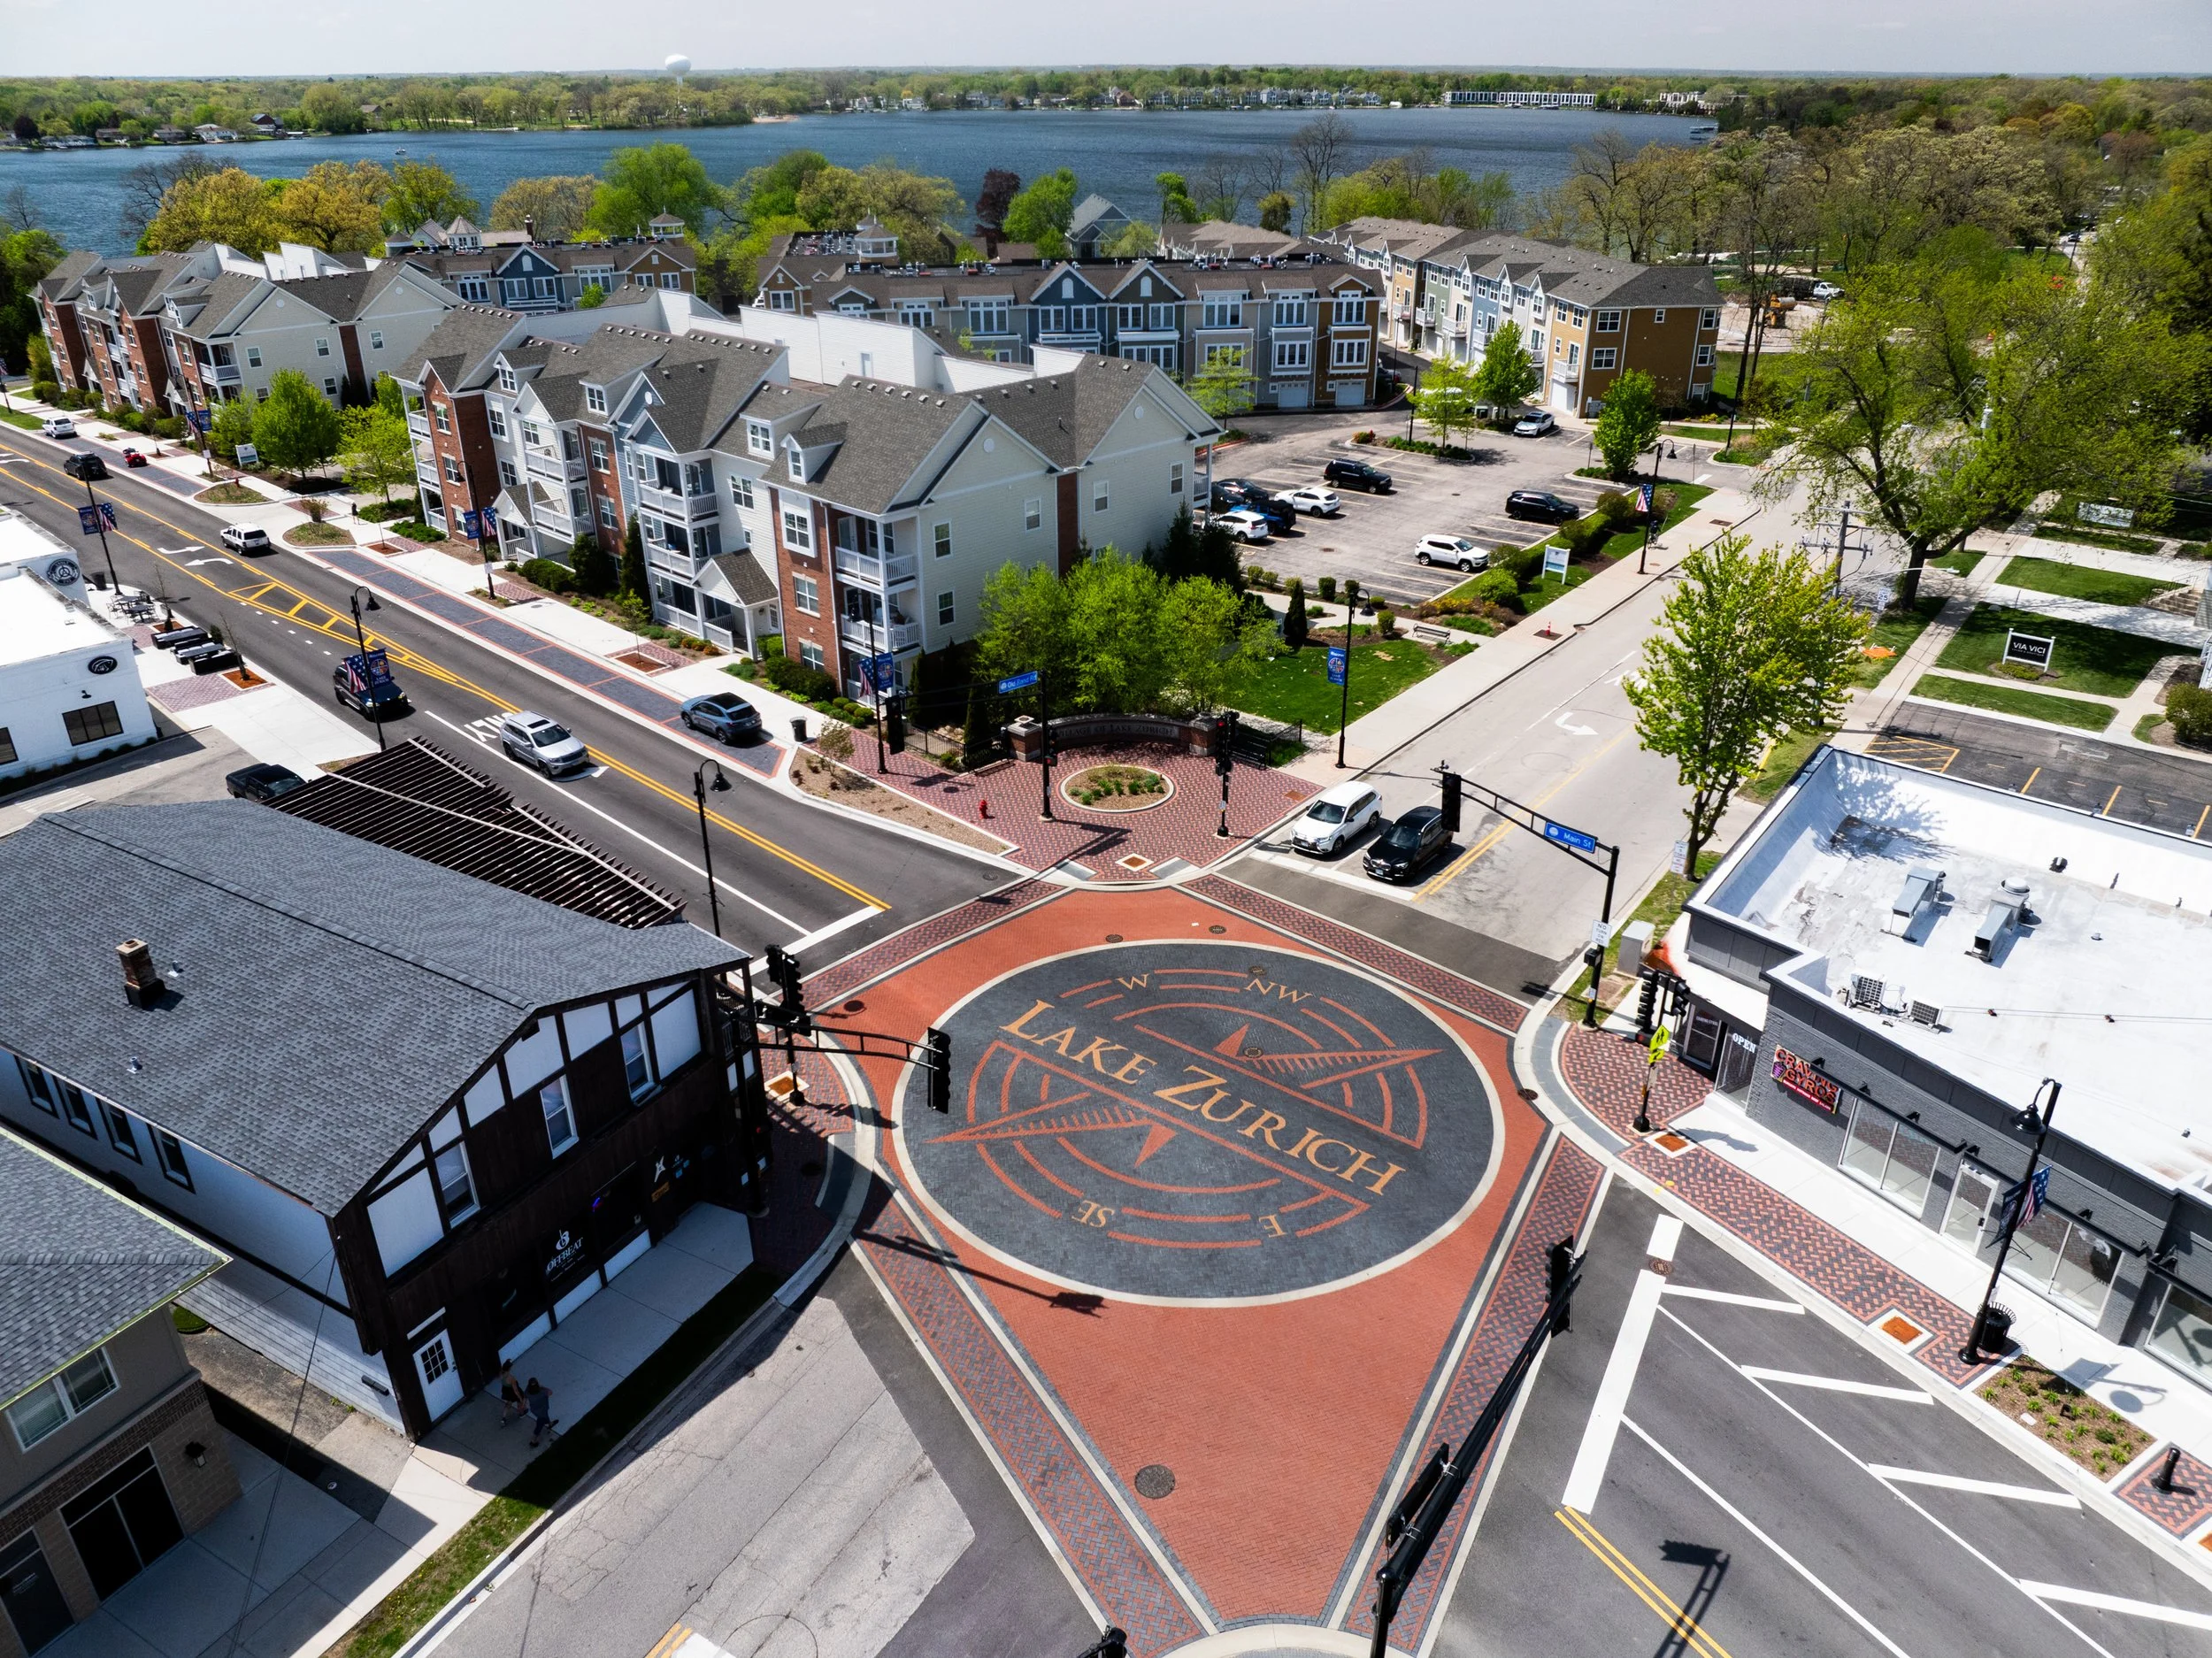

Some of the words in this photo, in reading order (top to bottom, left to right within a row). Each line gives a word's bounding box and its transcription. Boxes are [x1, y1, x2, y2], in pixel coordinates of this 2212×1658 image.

[2013, 641, 2027, 651] VIA
[2029, 644, 2046, 655] VICI
[1110, 723, 1129, 733] LAKE
[1134, 725, 1173, 736] ZURICH
[1563, 832, 1581, 844] Main
[1583, 839, 1592, 848] St
[1117, 974, 1149, 990] W
[1244, 978, 1313, 1004] NW
[1732, 1032, 1756, 1054] OPEN
[999, 999, 1158, 1085] LAKE
[1153, 1065, 1406, 1195] ZURICH
[1786, 1068, 1836, 1104] GYROS
[1071, 1200, 1115, 1228] SE
[1259, 1214, 1286, 1238] E
[547, 1237, 584, 1271] OFFBEAT
